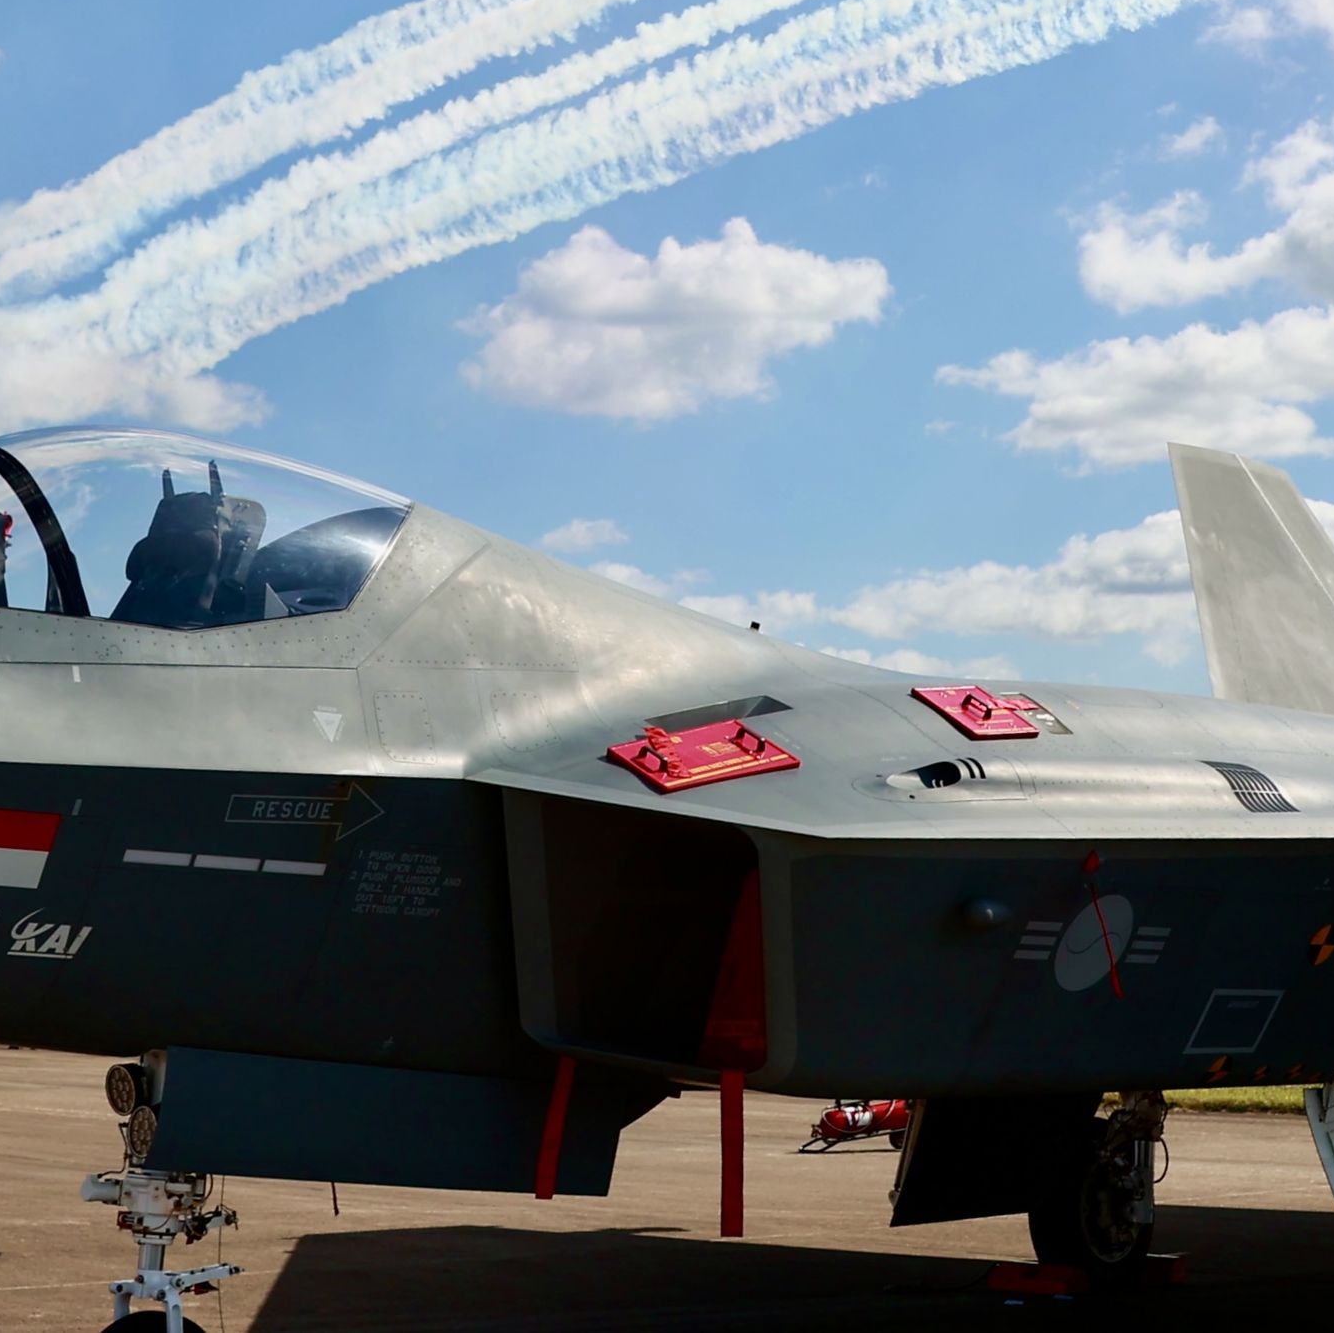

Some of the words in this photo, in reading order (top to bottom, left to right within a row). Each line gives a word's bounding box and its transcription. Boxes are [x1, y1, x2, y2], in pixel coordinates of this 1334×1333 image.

[252, 800, 335, 820] RESCUE
[368, 850, 396, 862] PUSH
[400, 853, 438, 865] BUTTON
[367, 861, 379, 871] TO
[385, 863, 411, 873] OPEN
[416, 865, 442, 875] DOOR
[362, 872, 389, 882] PUSH
[393, 874, 437, 885] PLUNGER
[442, 877, 462, 887] AND
[357, 882, 383, 893] PULL
[391, 884, 398, 894] T
[403, 885, 441, 896] HANDLE
[355, 893, 376, 903] OUT
[412, 896, 425, 906] TO
[351, 903, 398, 915] JETTISON
[403, 906, 441, 917] CANOPY
[8, 908, 93, 956] KAI
